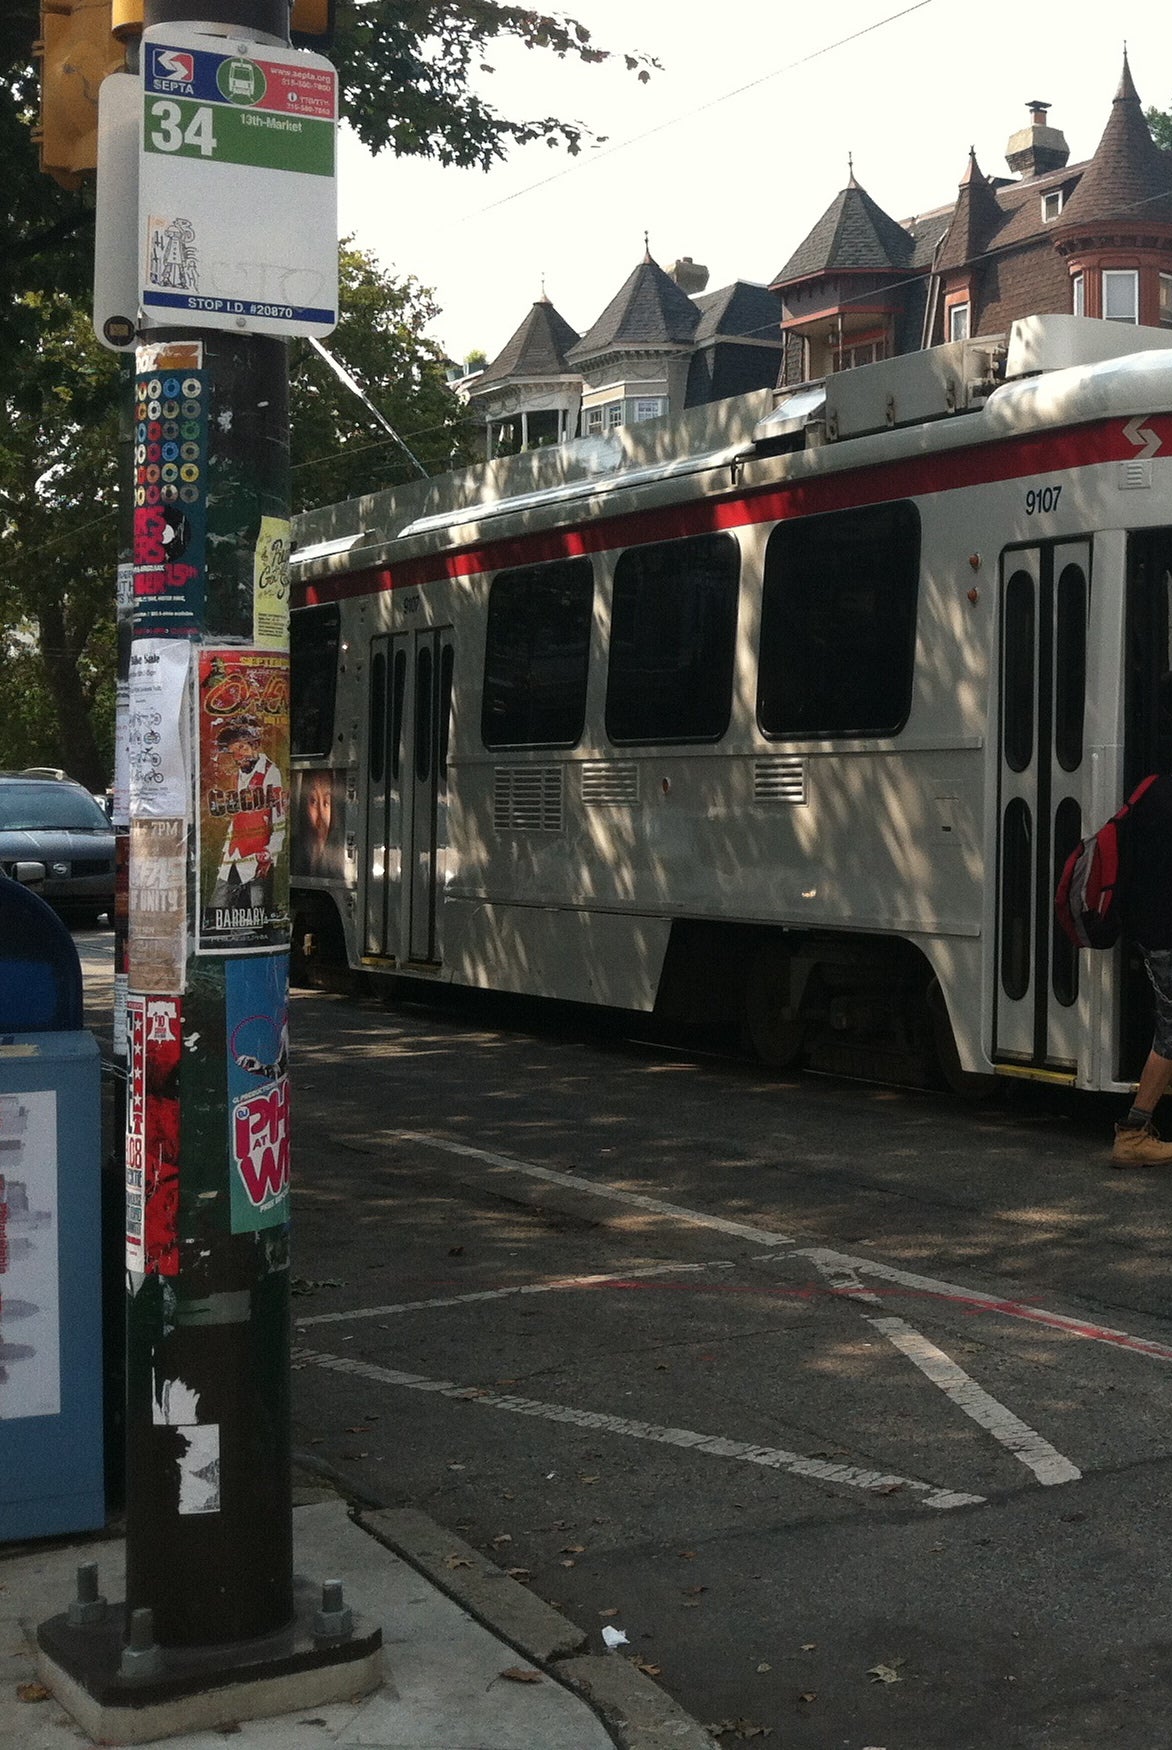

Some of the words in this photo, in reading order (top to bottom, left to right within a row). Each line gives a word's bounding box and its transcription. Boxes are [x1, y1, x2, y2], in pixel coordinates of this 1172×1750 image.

[270, 67, 332, 84] www.septa.org
[152, 78, 195, 95] SEPTA
[151, 100, 217, 156] 34
[240, 113, 303, 133] 13th-Market
[187, 298, 225, 312] STOP
[227, 301, 246, 314] I.D.
[250, 304, 294, 319] #20870
[1025, 485, 1062, 516] 9107
[151, 821, 178, 836] 7PM
[216, 908, 264, 928] BARBARY
[253, 1135, 268, 1150] AT
